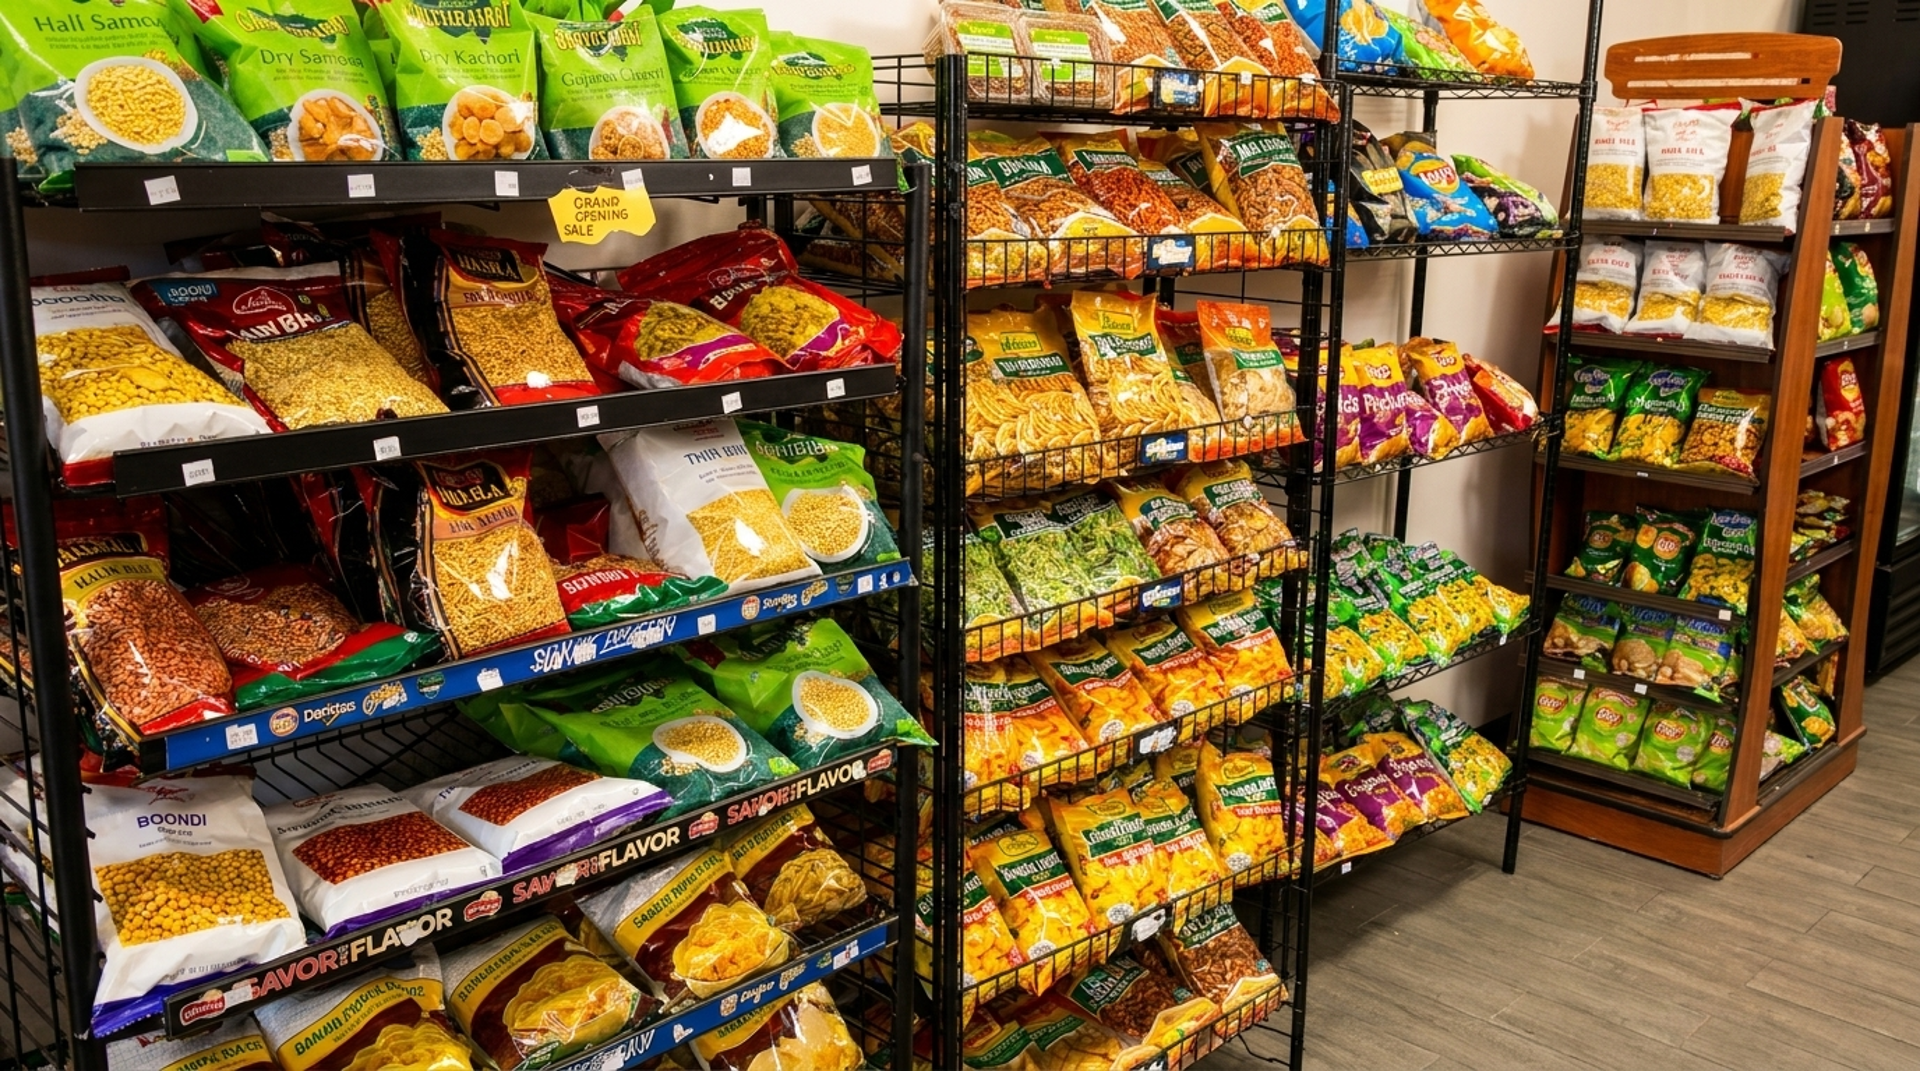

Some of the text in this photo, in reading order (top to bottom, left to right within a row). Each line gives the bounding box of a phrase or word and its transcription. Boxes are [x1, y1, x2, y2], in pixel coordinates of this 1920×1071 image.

[564, 224, 594, 236] SALE
[137, 813, 207, 828] BOONDI
[599, 826, 680, 873] FLAVOR
